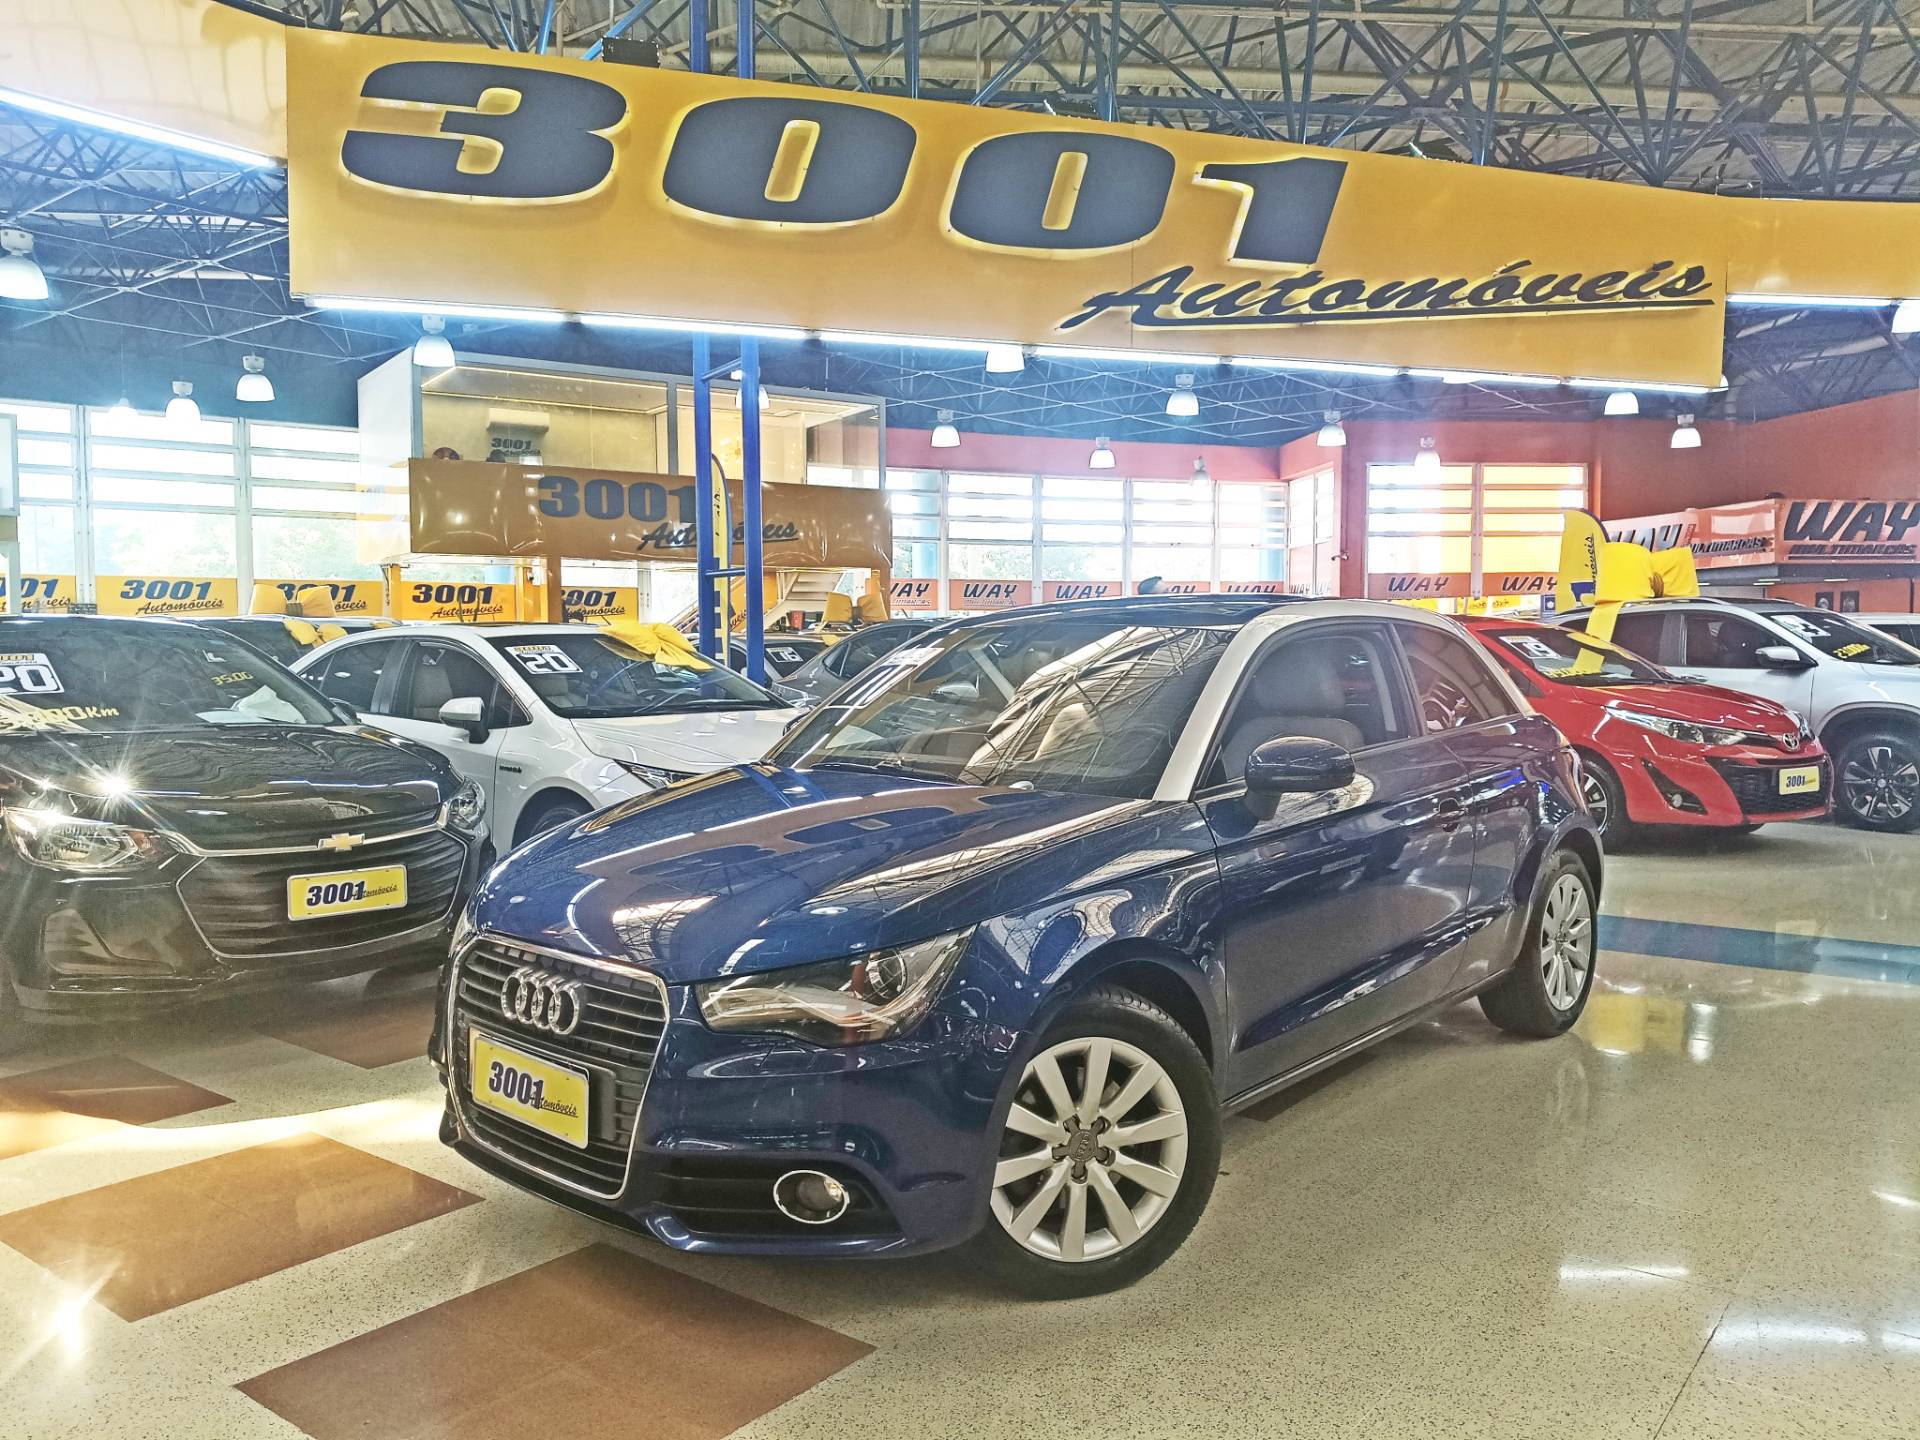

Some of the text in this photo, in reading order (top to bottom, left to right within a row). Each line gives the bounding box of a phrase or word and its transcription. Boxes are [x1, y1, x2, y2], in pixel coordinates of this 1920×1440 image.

[340, 60, 1349, 266] 3001
[1056, 258, 1716, 331] Automóveis
[537, 475, 697, 524] 3001
[1783, 501, 1920, 542] WAY
[119, 579, 213, 601] 3001
[412, 583, 494, 605] 3001
[890, 582, 930, 598] AY
[963, 583, 1018, 598] WAY
[1055, 584, 1108, 599] WAY
[1387, 576, 1450, 592] WAY
[135, 598, 225, 616] Automóveis
[560, 589, 617, 607] 001
[518, 652, 579, 673] 20
[1785, 774, 1806, 788] 3001
[306, 880, 365, 907] 3001
[488, 1060, 545, 1111] 3001
